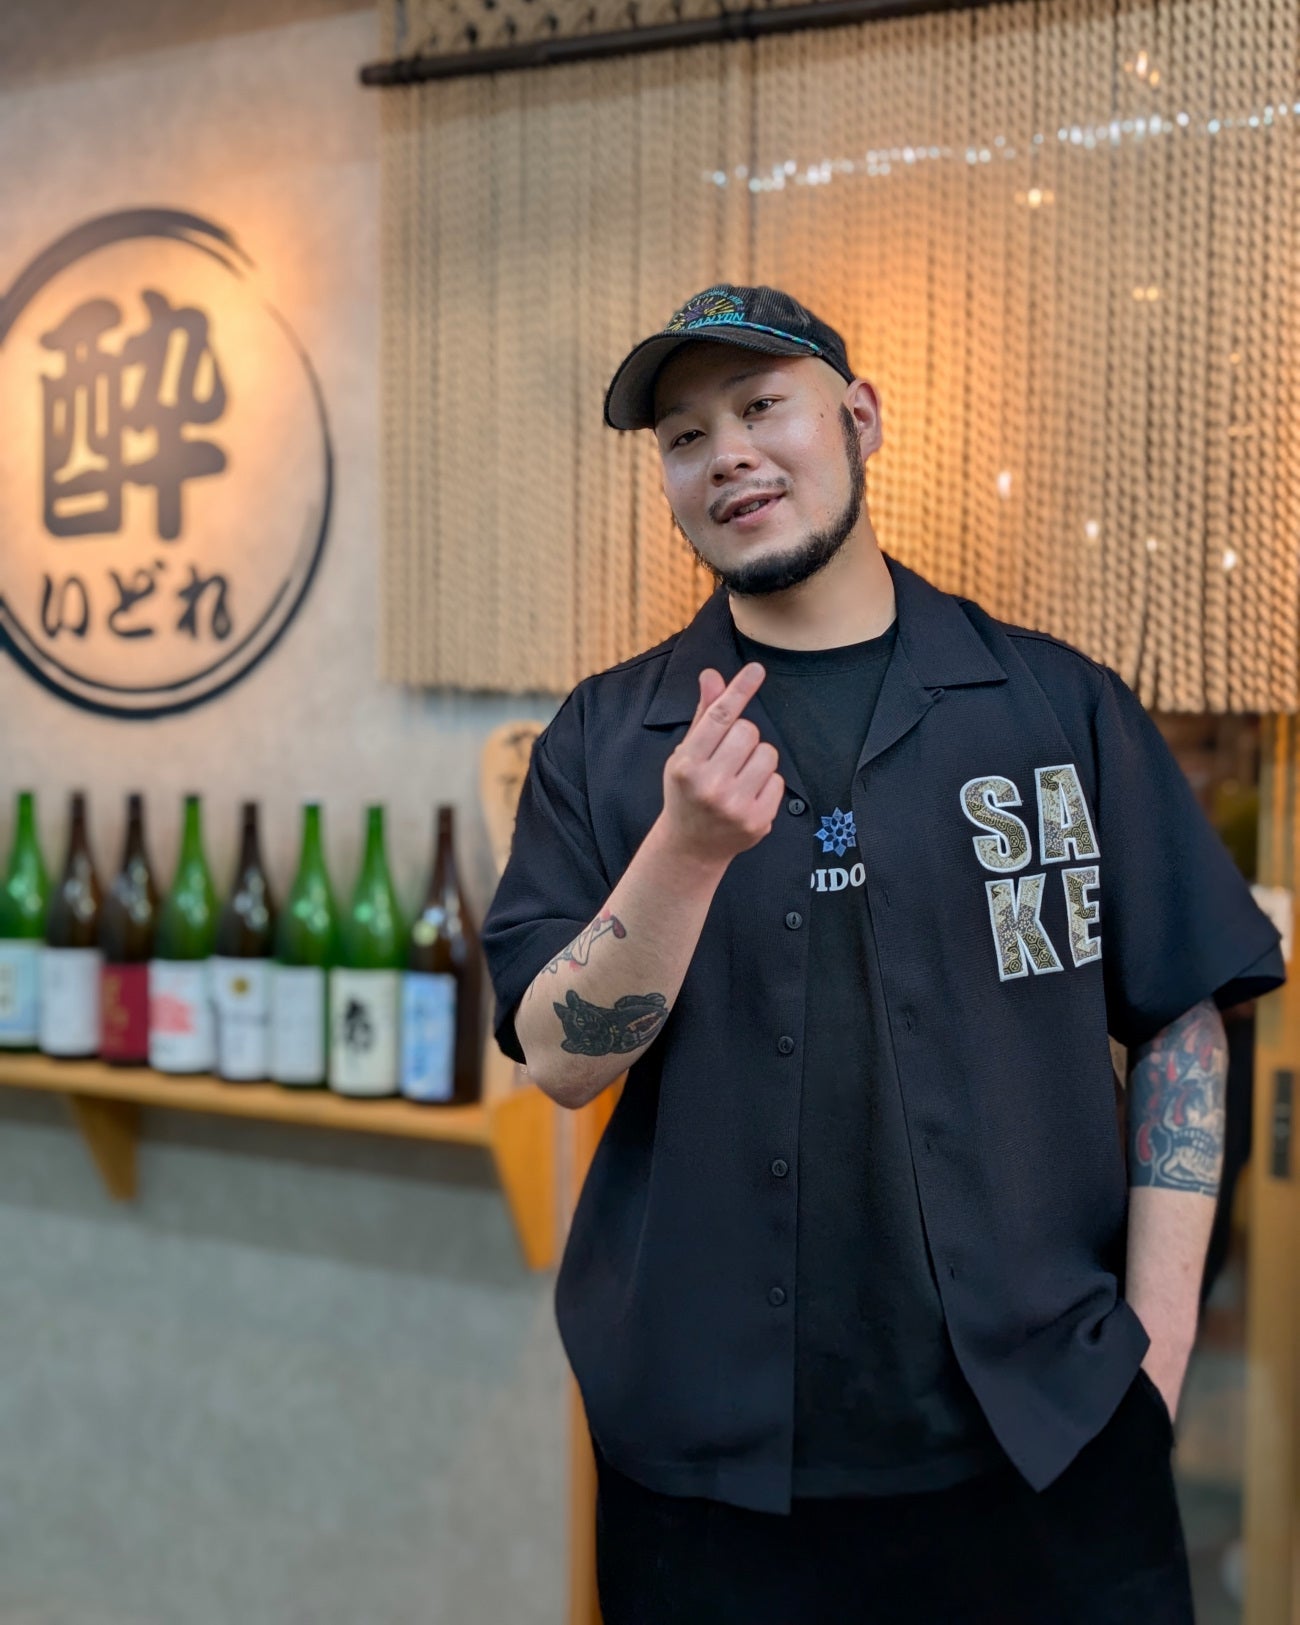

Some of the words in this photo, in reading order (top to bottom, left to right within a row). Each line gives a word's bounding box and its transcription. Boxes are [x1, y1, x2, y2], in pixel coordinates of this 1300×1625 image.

[688, 312, 745, 329] CANYON
[41, 288, 228, 540] 酔
[41, 561, 231, 640] いどれ
[810, 863, 866, 892] IDO
